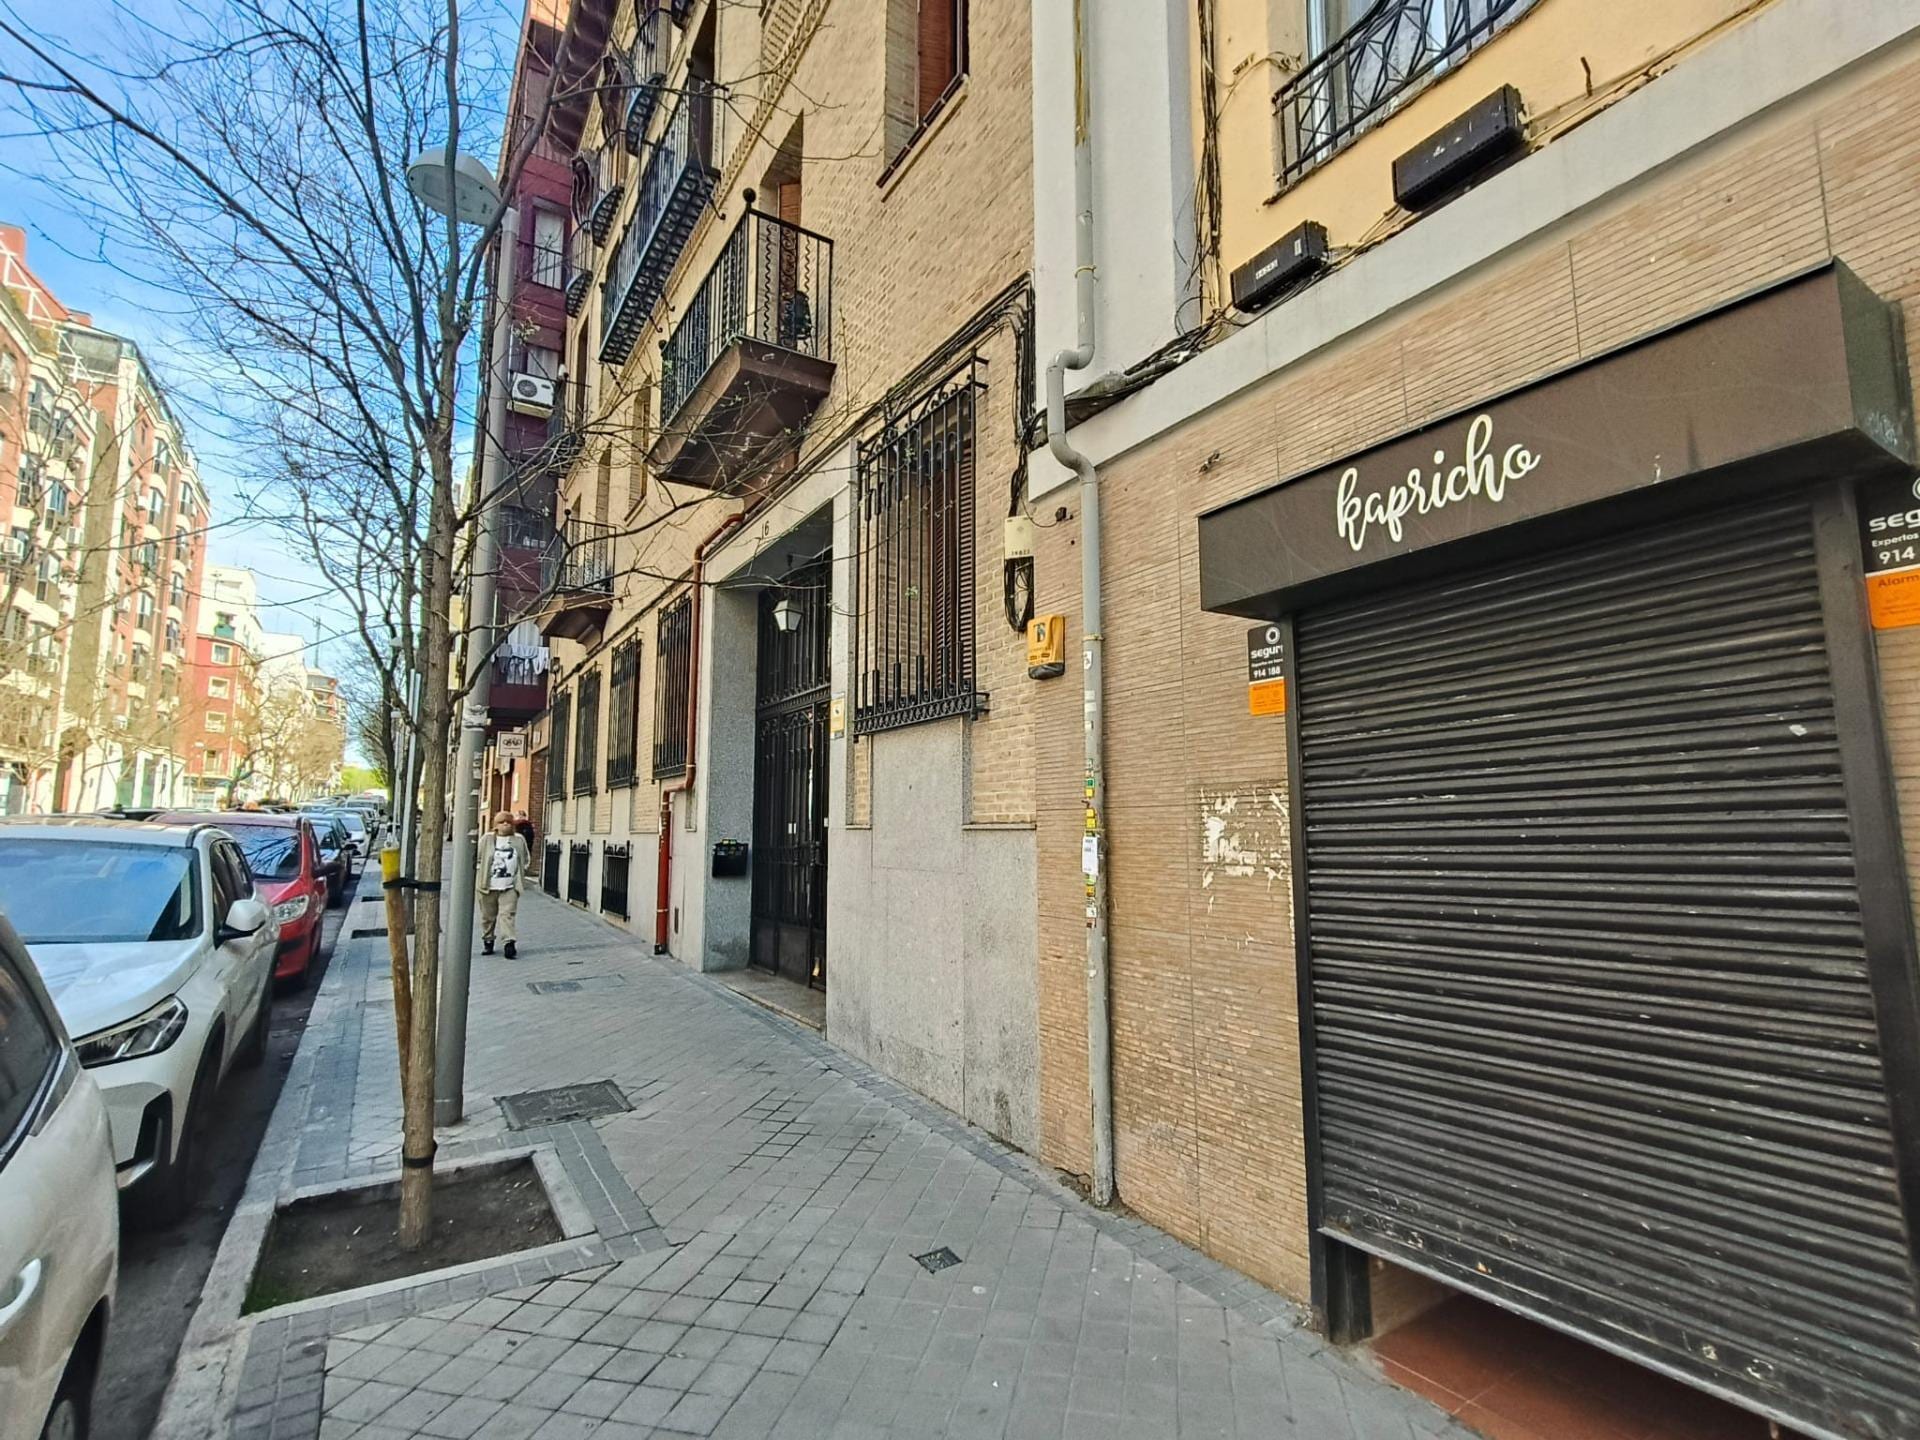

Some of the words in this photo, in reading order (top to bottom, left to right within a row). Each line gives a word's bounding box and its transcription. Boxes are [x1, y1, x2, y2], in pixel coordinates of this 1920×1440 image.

[1337, 414, 1541, 551] kapricho
[1871, 532, 1919, 548] Expertos
[1879, 546, 1916, 565] 914
